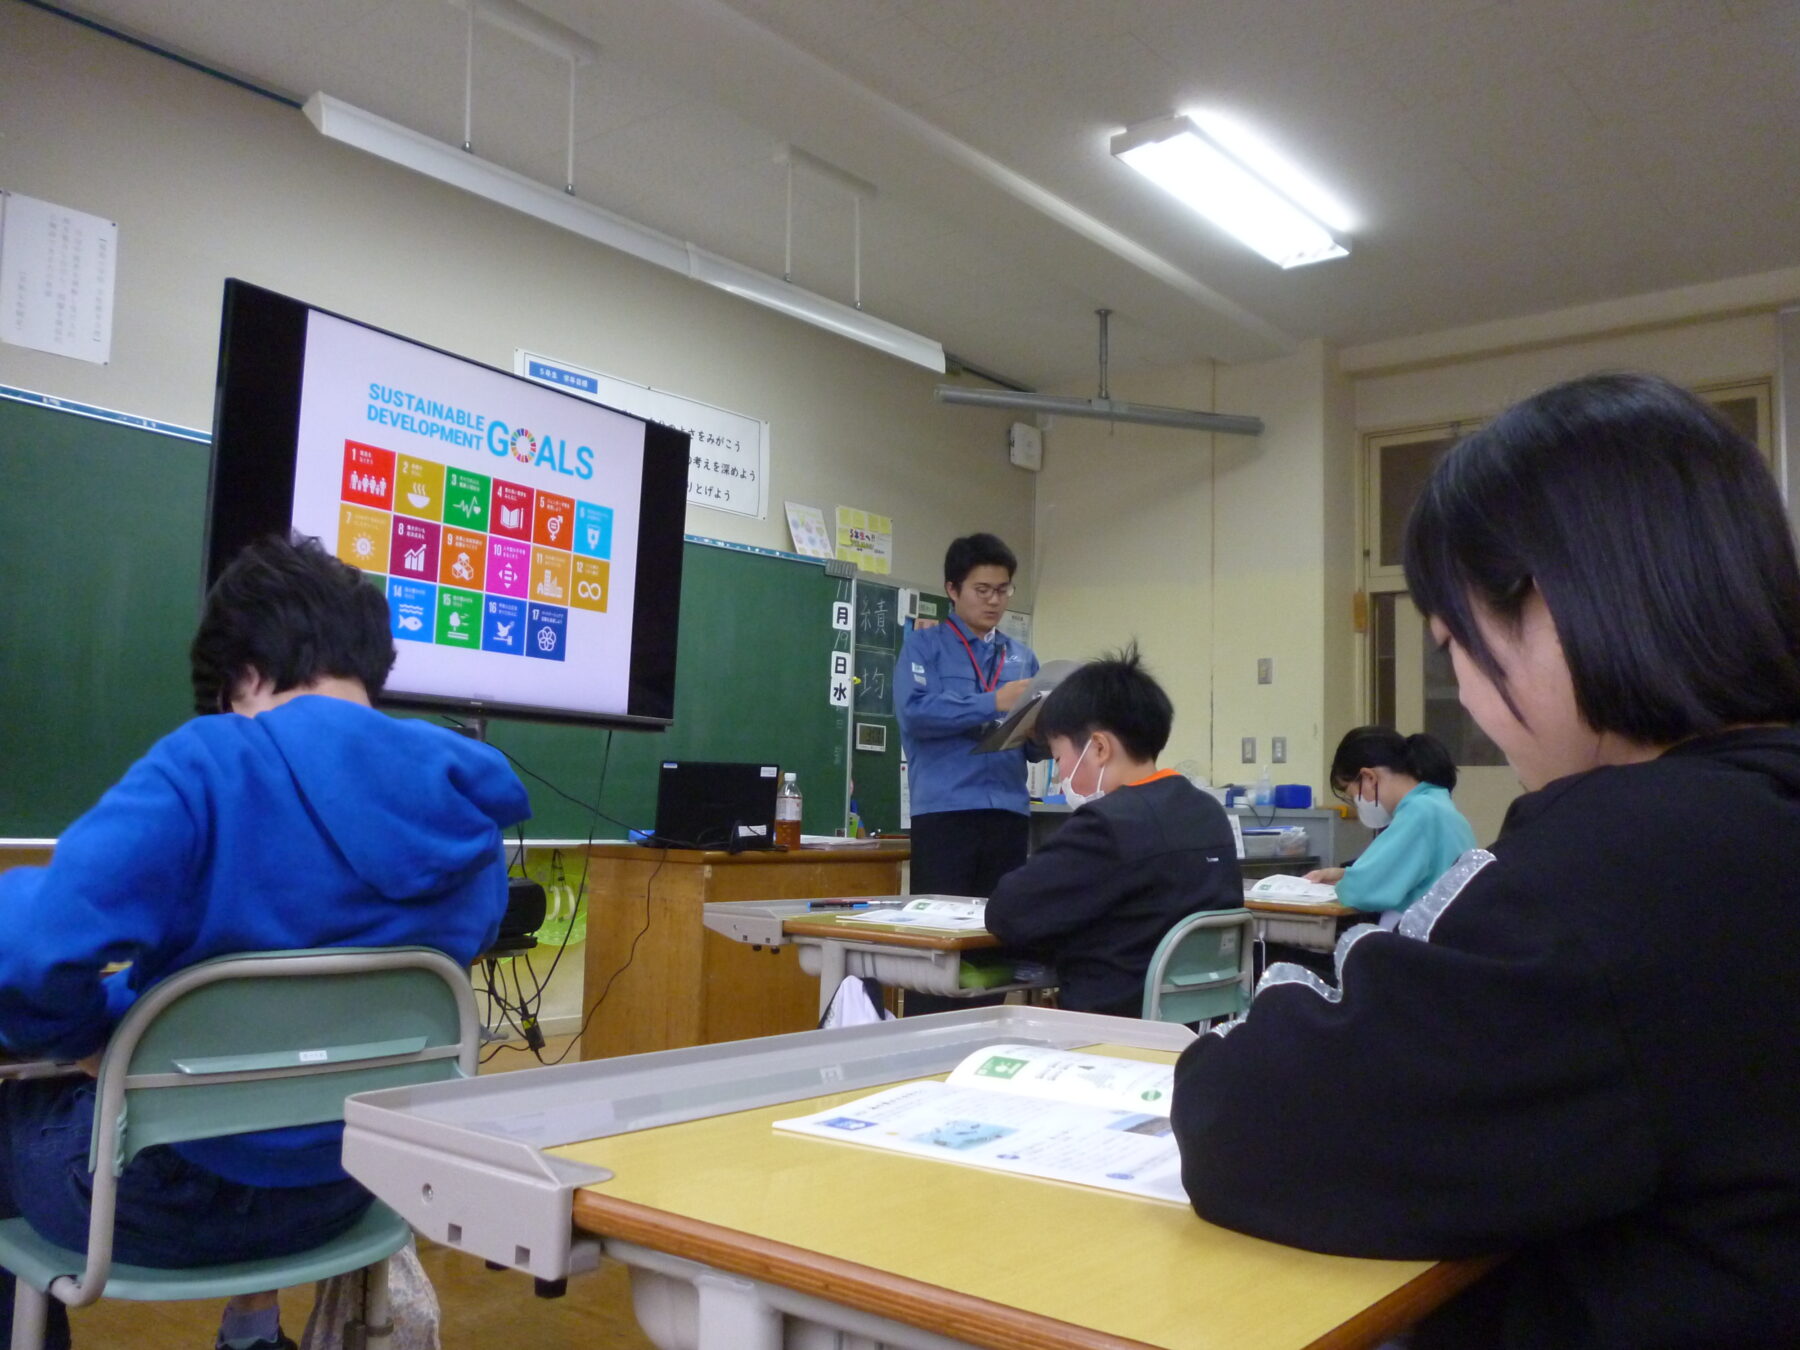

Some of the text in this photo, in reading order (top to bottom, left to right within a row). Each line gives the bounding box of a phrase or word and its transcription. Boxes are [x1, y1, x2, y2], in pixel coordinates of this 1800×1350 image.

[368, 383, 485, 432] SUSTAINABLE
[367, 404, 595, 480] DEVELOPMENT GOALS
[352, 448, 356, 461] 1
[402, 461, 408, 473] 2
[451, 474, 457, 486] 3
[497, 486, 502, 498] 4
[540, 496, 544, 508] 5
[398, 523, 404, 536] 8
[494, 544, 502, 556] 10
[536, 553, 542, 564] 11
[394, 584, 402, 597] 14
[532, 609, 540, 620] 17
[836, 606, 848, 625] 月
[860, 596, 888, 636] 績
[834, 656, 846, 674] 日
[858, 667, 885, 700] 均
[833, 682, 847, 701] 水
